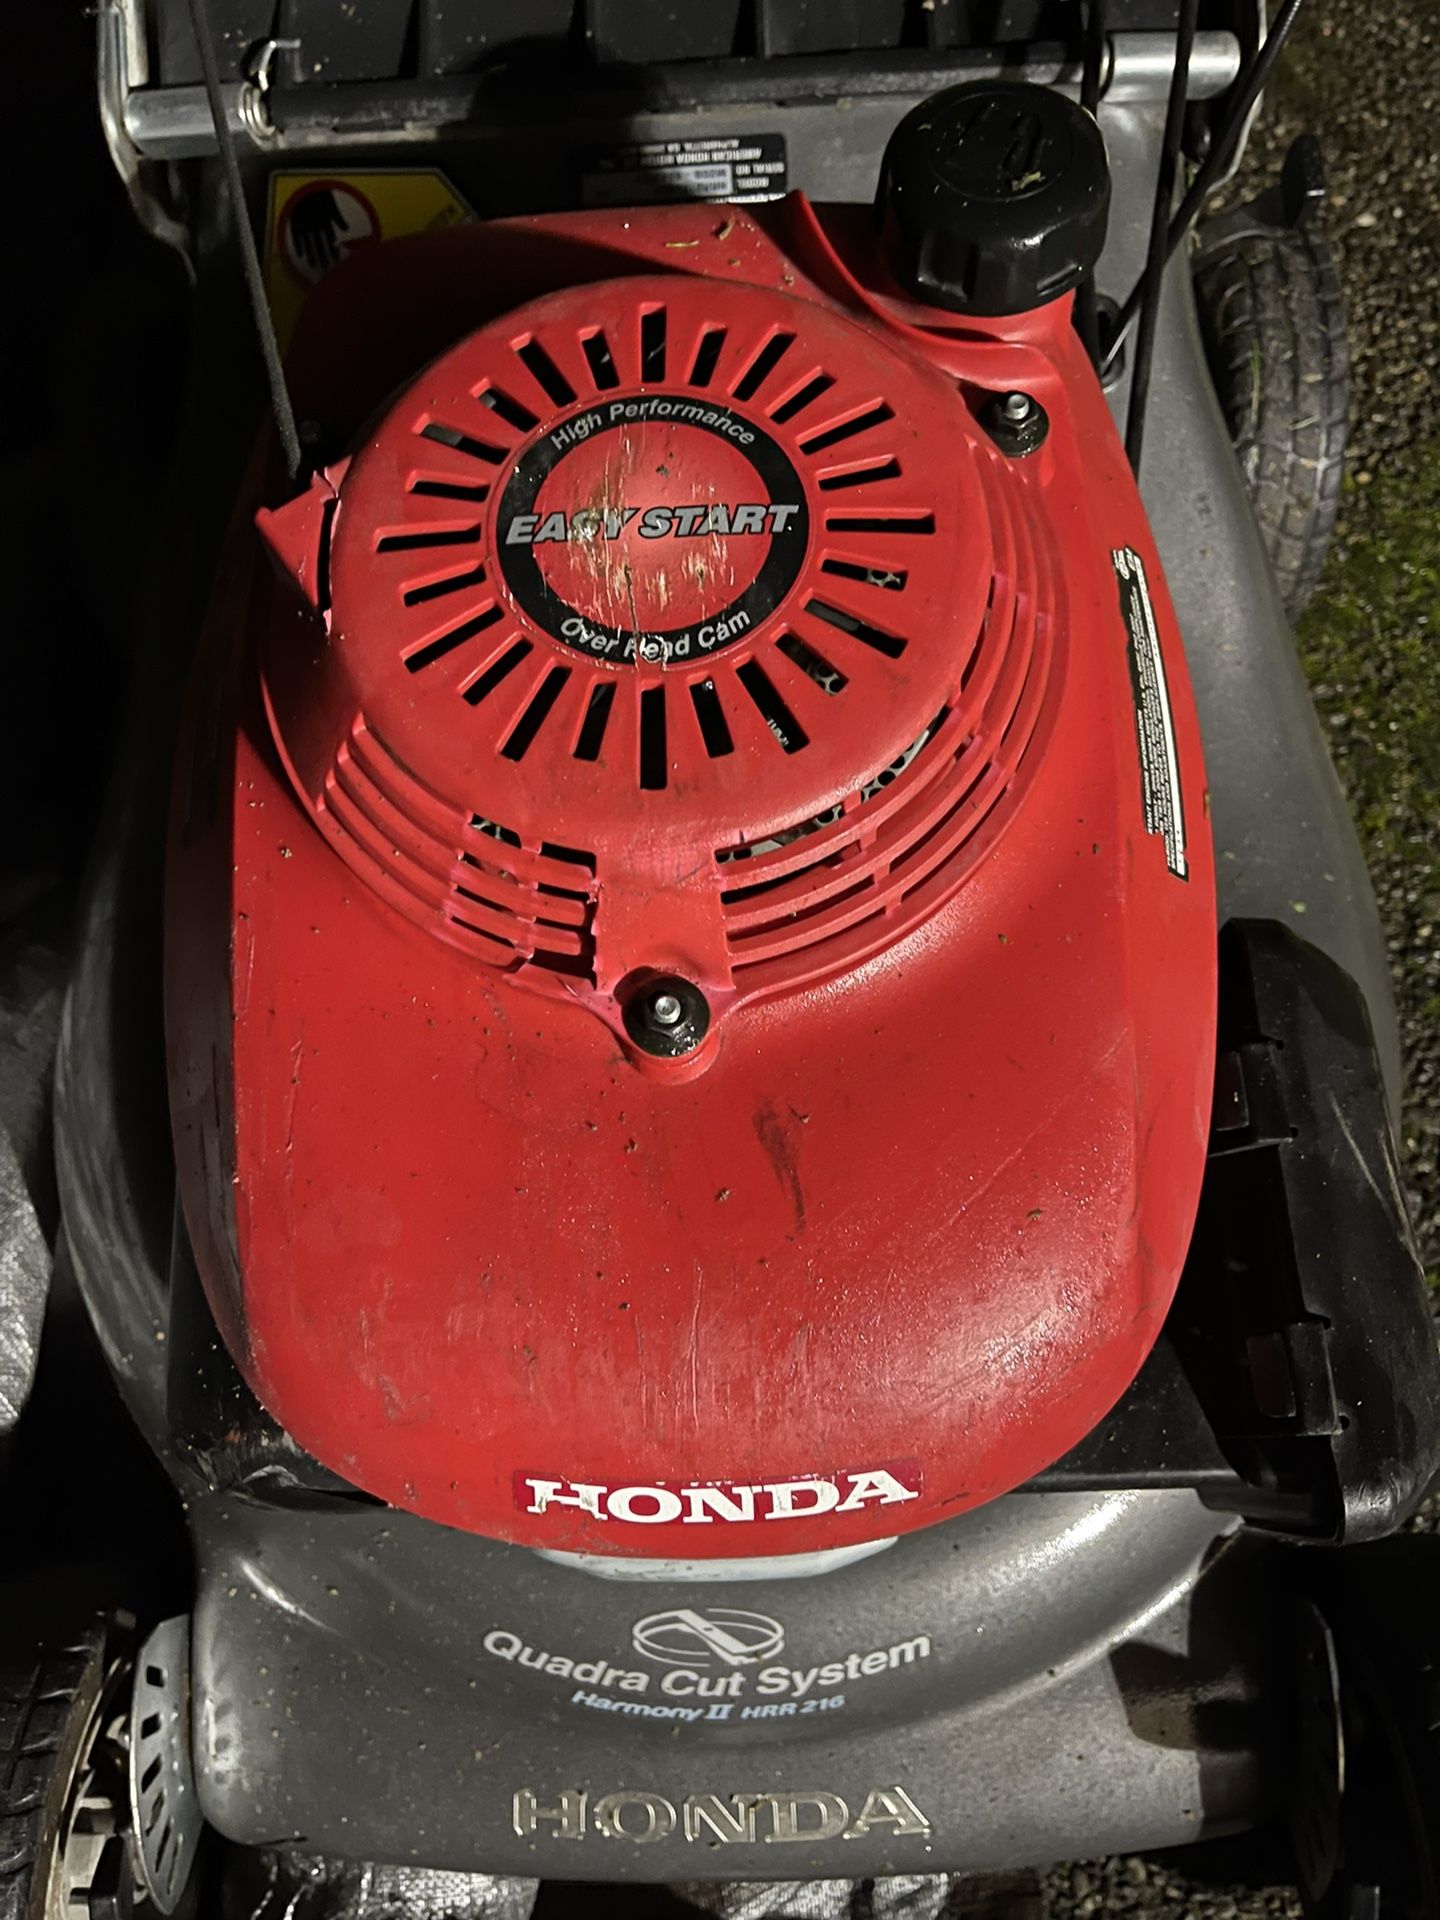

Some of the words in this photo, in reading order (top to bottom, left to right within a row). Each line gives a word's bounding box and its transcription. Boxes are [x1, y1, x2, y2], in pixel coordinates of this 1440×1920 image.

[551, 411, 603, 450] High
[609, 398, 755, 445] Performance
[505, 506, 643, 545] EASY
[638, 504, 800, 539] START
[560, 617, 621, 653] Over
[697, 610, 751, 650] Cam
[525, 1469, 919, 1523] HONDA
[482, 1630, 649, 1694] Quadra
[660, 1669, 745, 1697] Cut
[755, 1633, 932, 1701] System
[571, 1690, 703, 1721] Harmony
[703, 1703, 735, 1720] II
[740, 1701, 798, 1719] HRR
[799, 1694, 846, 1714] 216
[512, 1785, 932, 1844] HONDA
